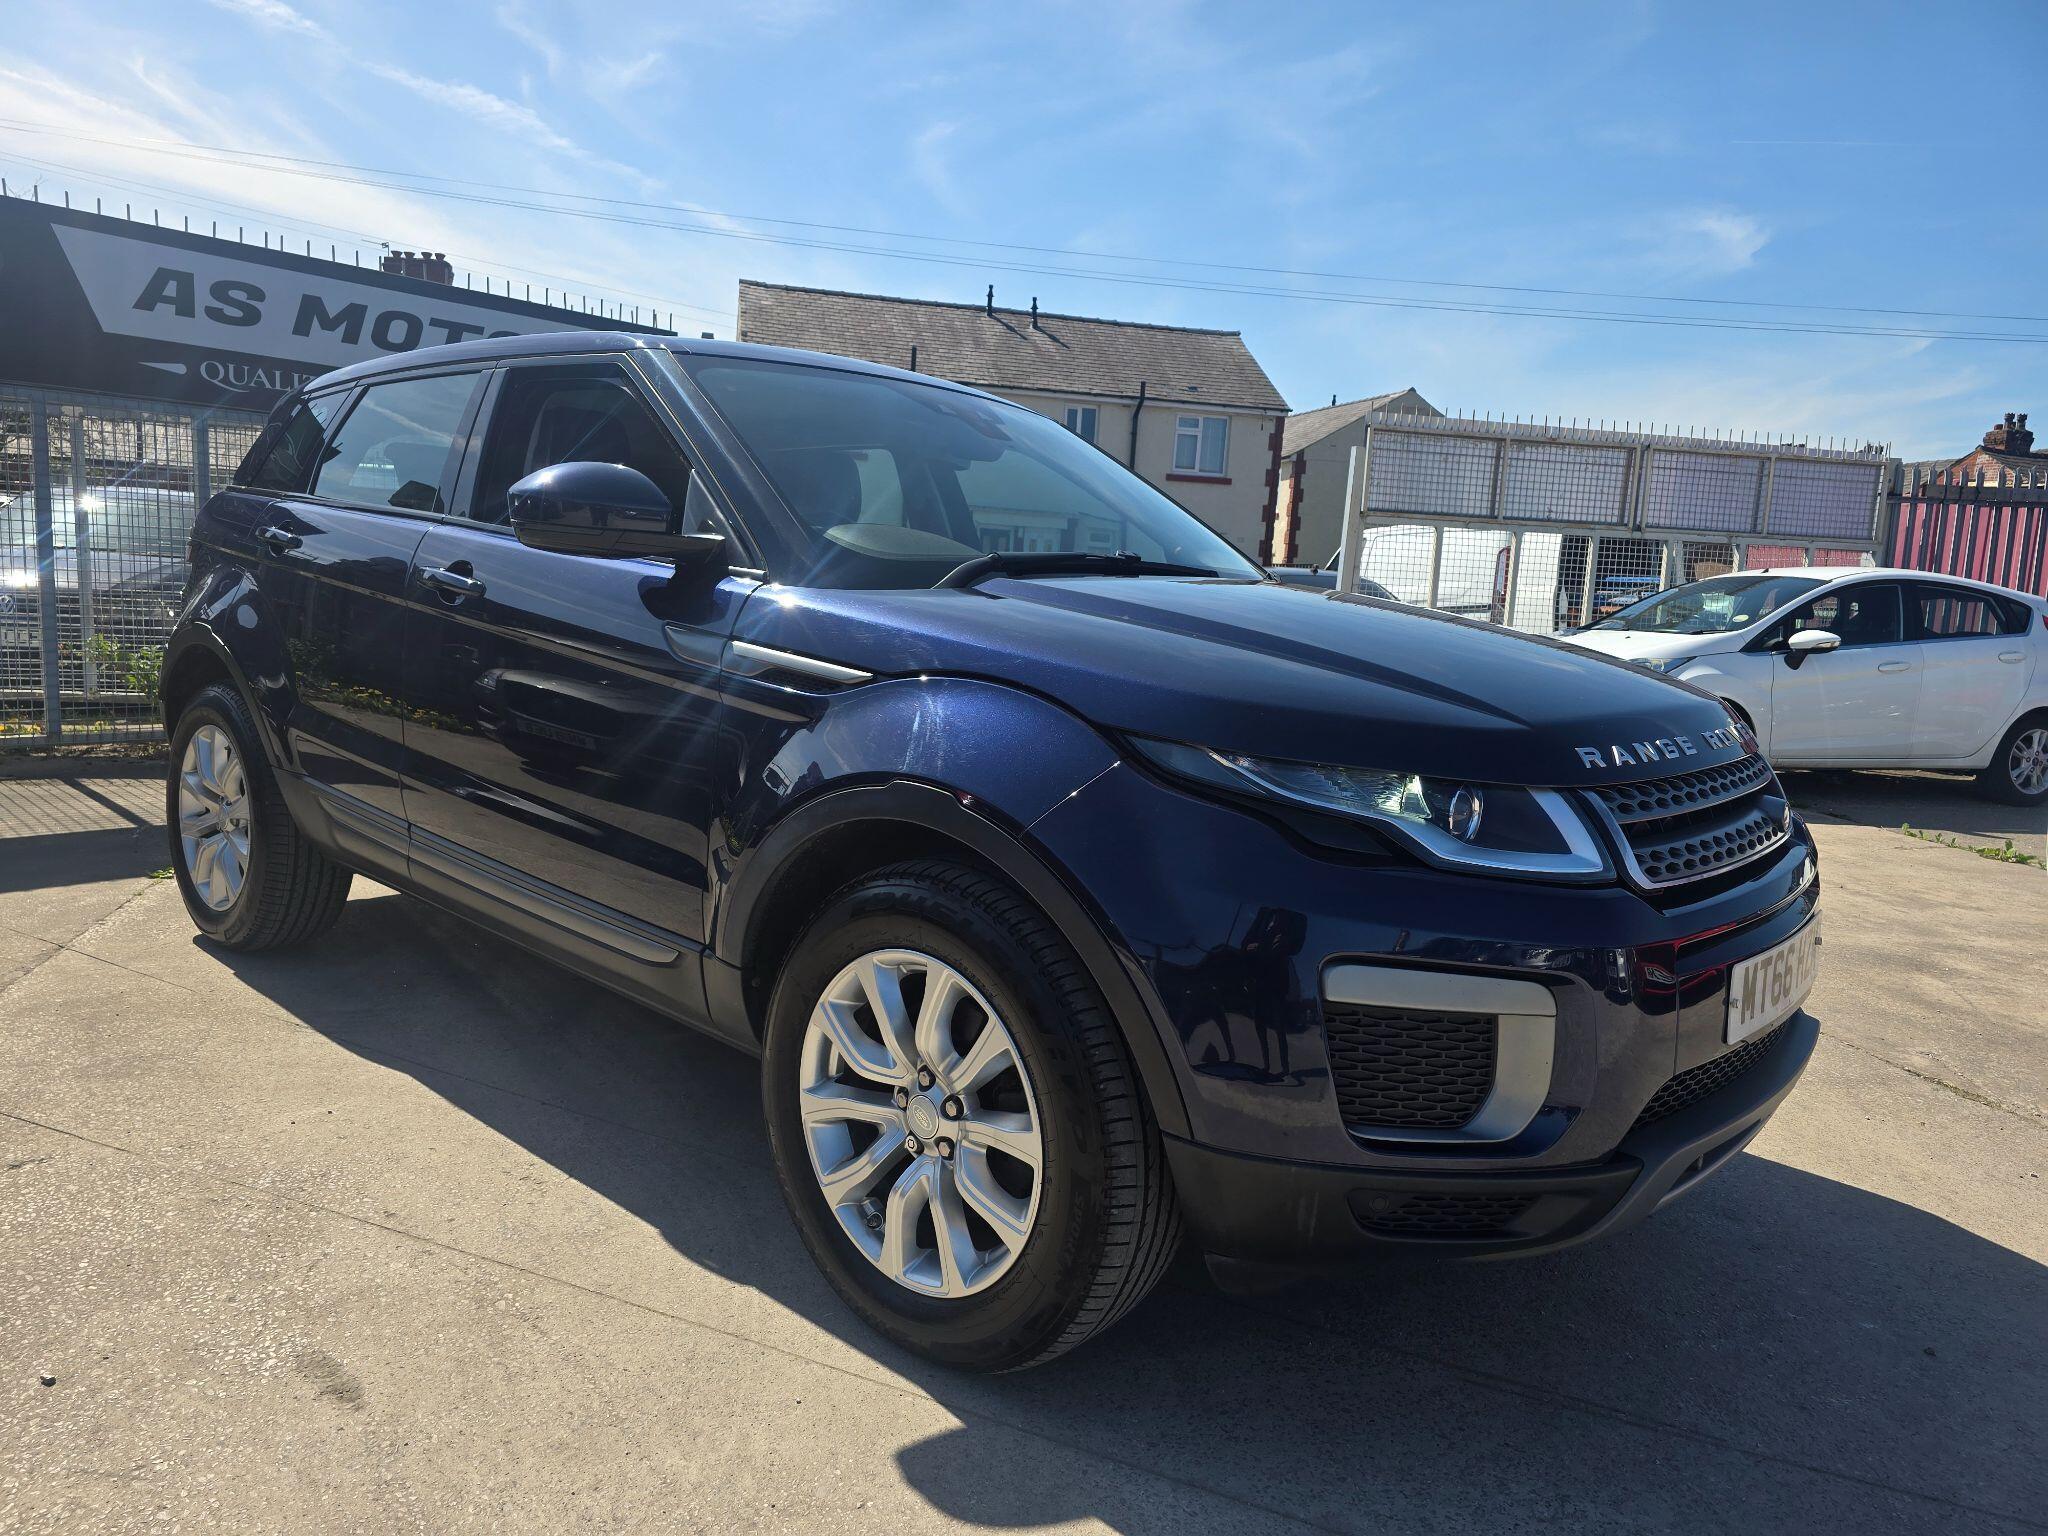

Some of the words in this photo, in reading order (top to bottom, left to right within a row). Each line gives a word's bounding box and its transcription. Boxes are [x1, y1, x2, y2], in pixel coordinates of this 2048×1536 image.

[132, 266, 266, 327] AS
[292, 293, 522, 353] MOT
[1575, 736, 1698, 769] RANGE
